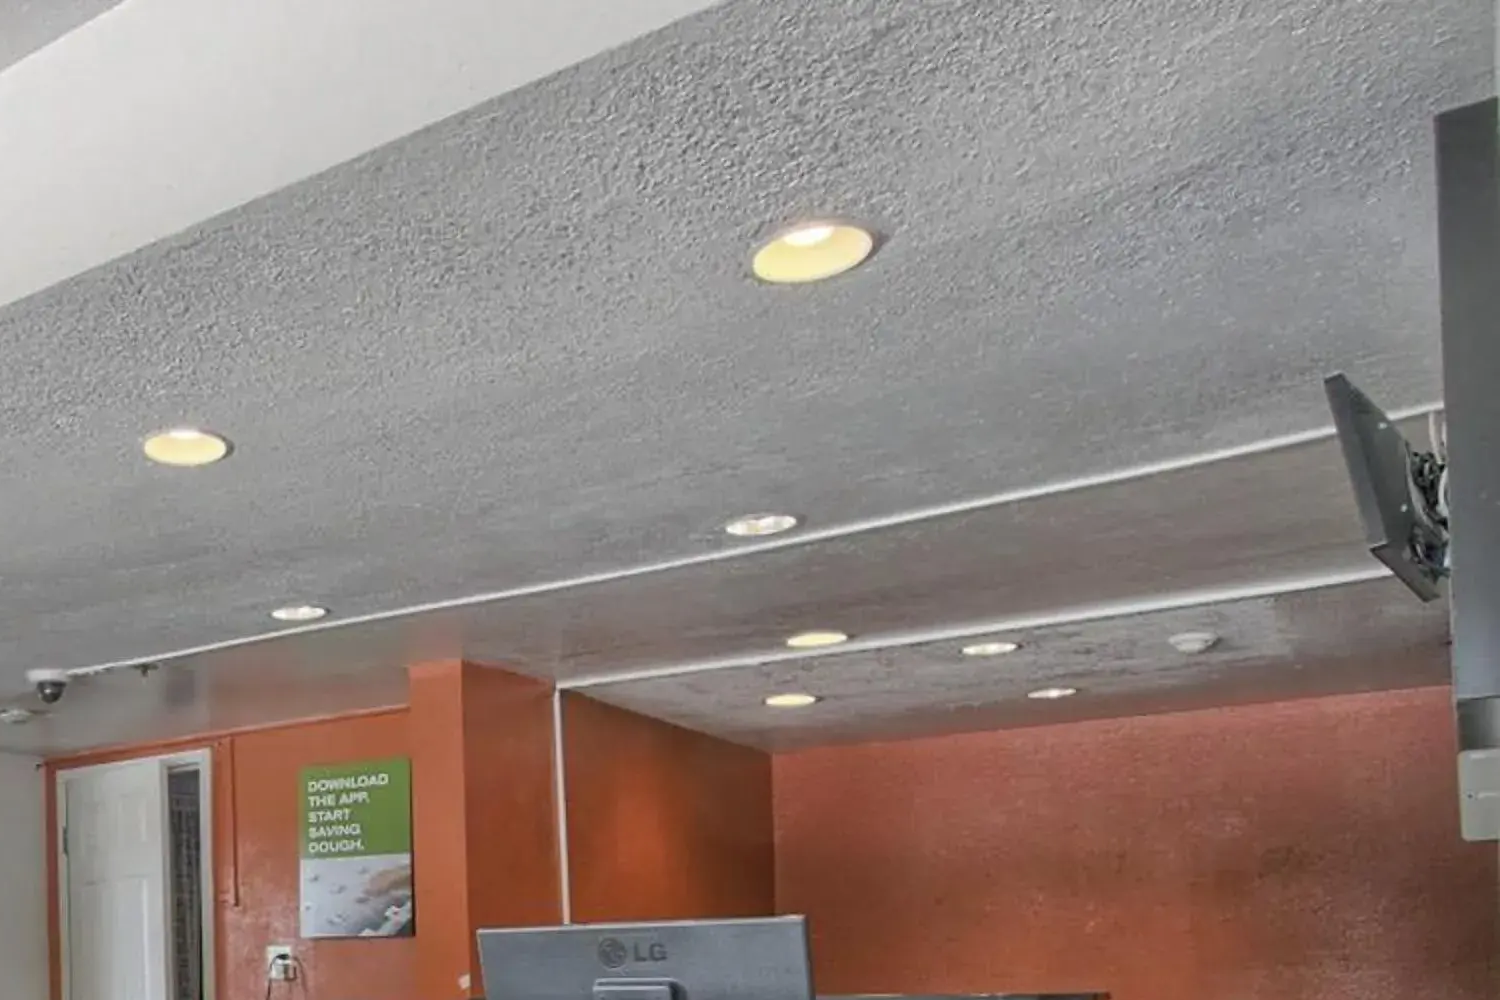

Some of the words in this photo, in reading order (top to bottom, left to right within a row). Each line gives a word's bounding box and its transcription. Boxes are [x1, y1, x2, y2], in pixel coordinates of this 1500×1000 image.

[307, 773, 389, 793] DOWNLOAD
[307, 793, 336, 808] THE
[307, 808, 351, 823] START
[308, 823, 361, 838] SAVING
[308, 838, 365, 853] DOUGH.
[633, 941, 668, 962] LG
